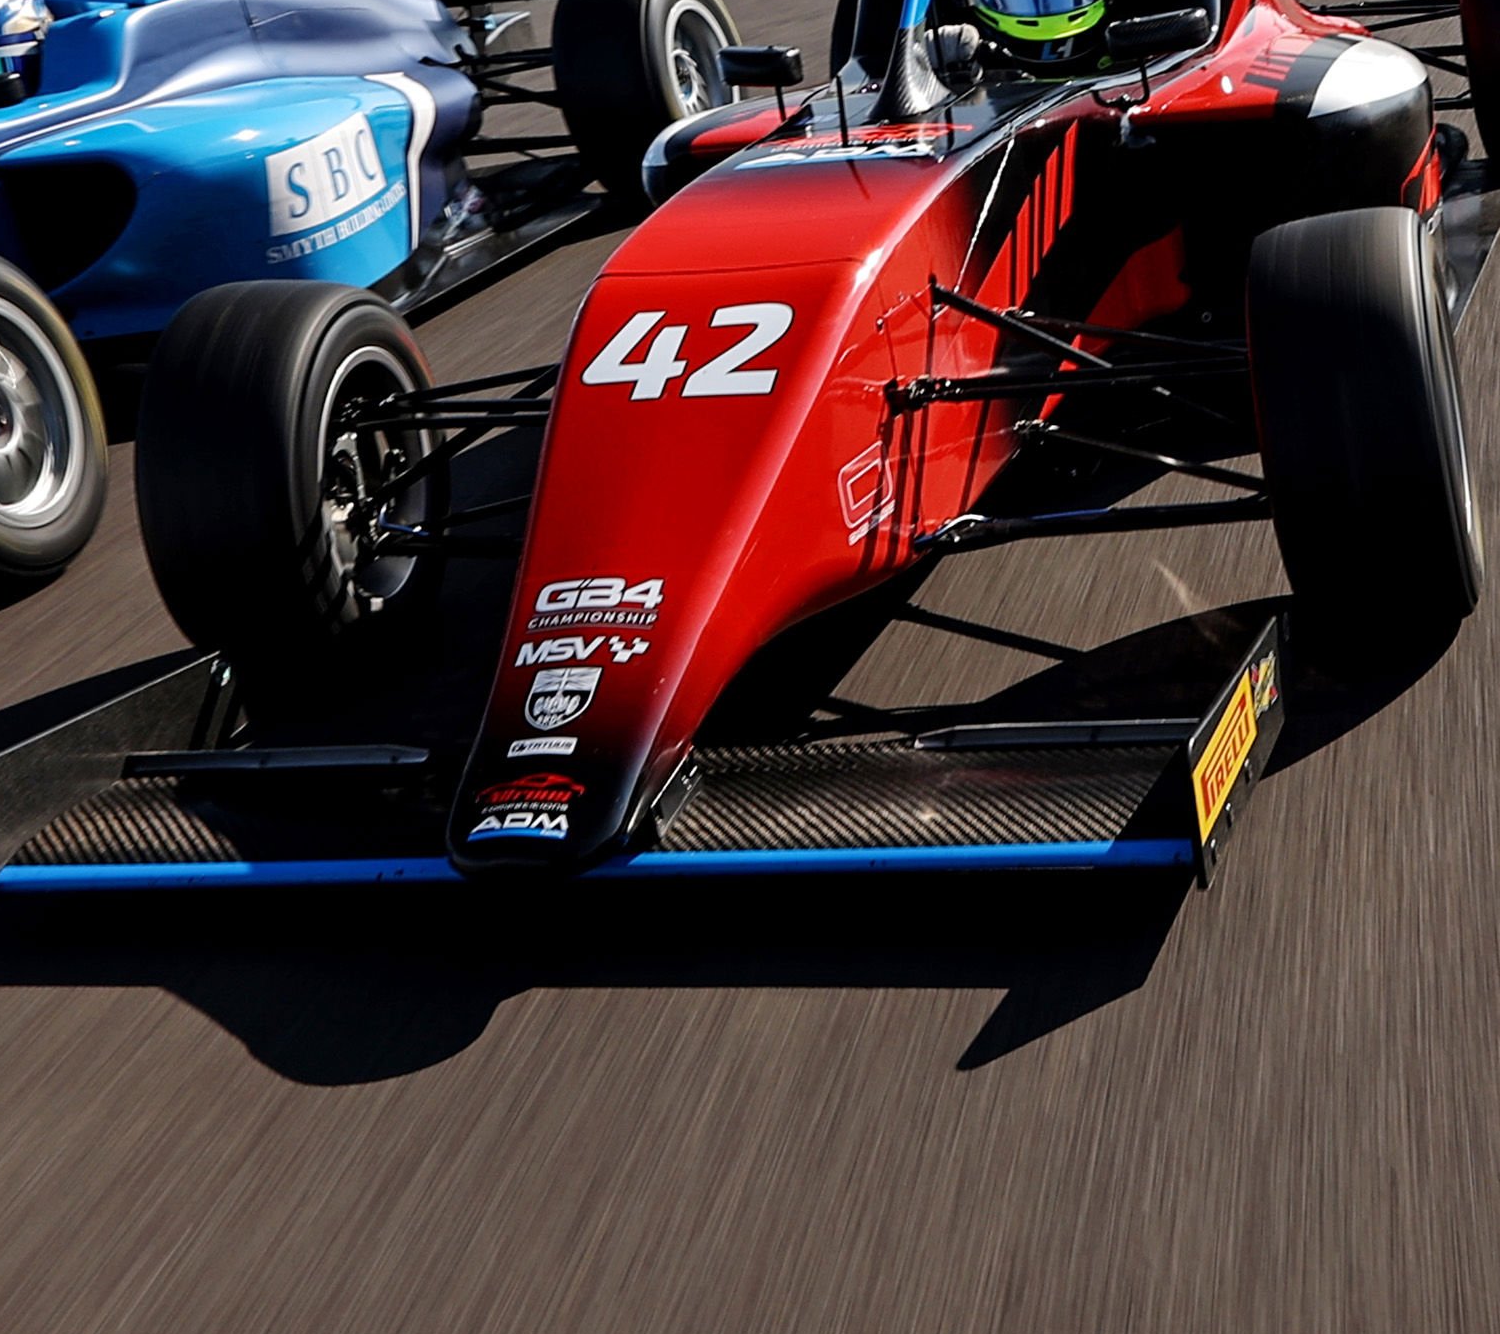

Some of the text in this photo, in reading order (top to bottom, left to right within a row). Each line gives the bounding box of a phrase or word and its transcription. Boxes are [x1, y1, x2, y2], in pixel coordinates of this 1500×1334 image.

[286, 129, 377, 219] SBC
[580, 301, 794, 402] 42
[527, 611, 658, 630] CHAMPIONSHIP
[535, 577, 665, 613] GB4
[514, 636, 607, 668] MSV
[1201, 693, 1251, 820] PIRELLI
